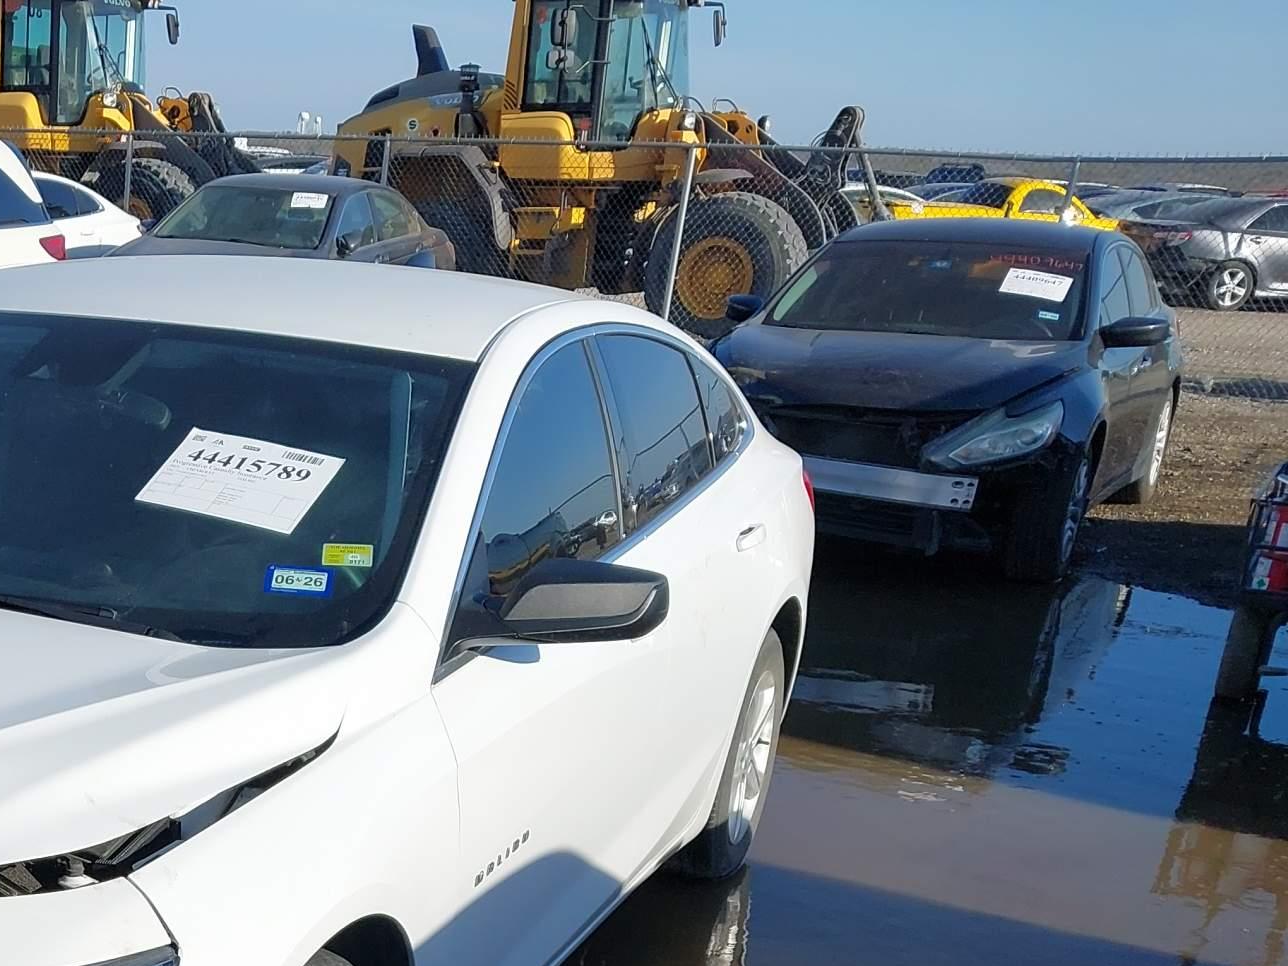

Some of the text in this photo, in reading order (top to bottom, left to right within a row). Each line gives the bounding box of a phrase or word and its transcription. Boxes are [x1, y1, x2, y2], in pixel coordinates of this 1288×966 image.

[408, 120, 417, 130] S
[187, 448, 312, 482] 44415789
[474, 829, 530, 888] MALIBU
